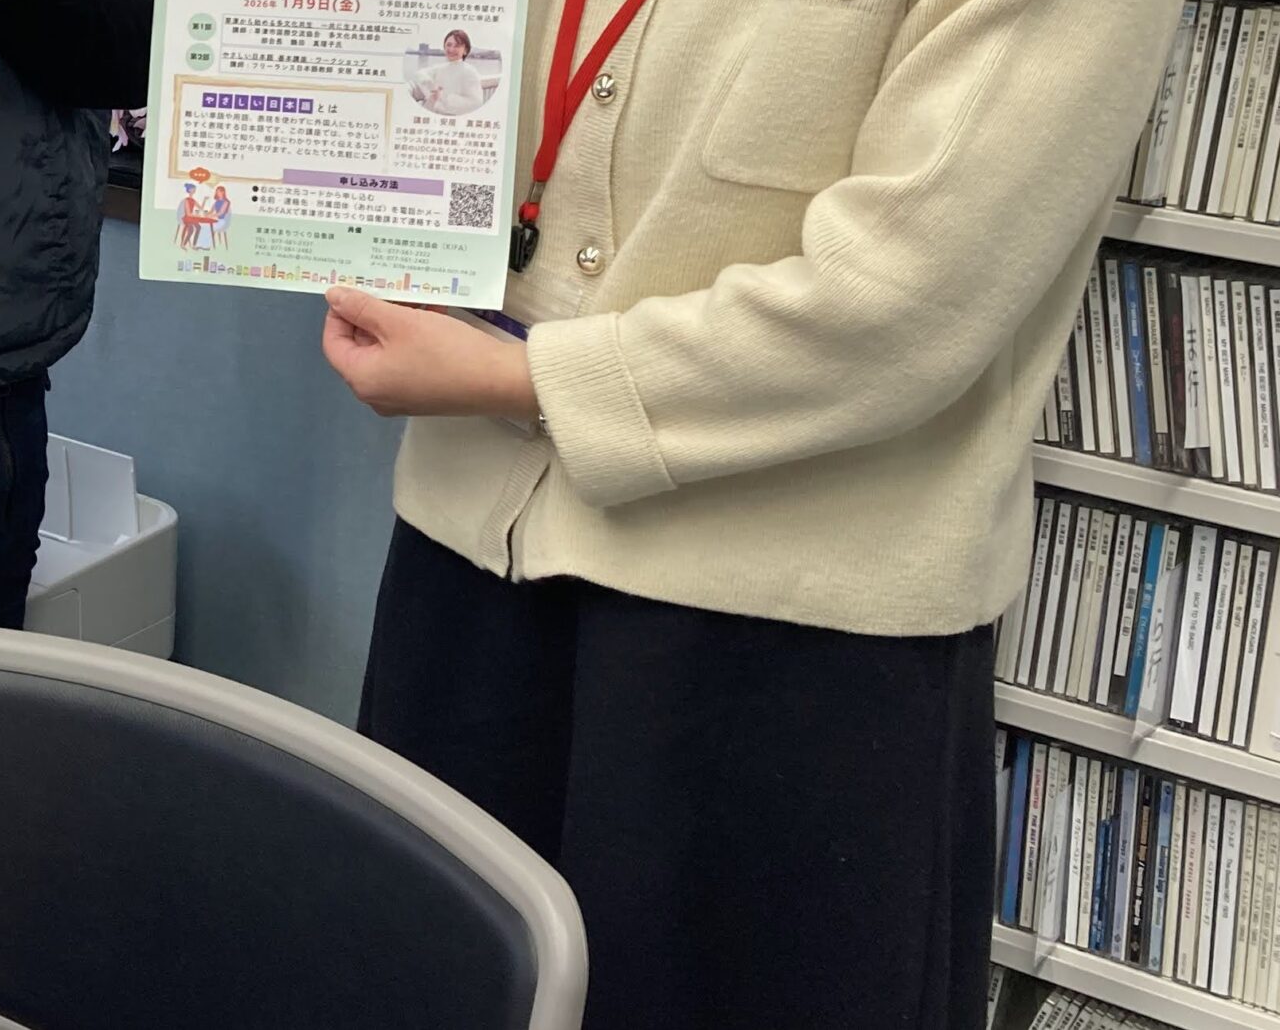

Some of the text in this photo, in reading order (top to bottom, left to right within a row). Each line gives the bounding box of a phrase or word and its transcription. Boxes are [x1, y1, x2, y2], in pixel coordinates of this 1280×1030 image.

[204, 94, 338, 113] やさしい日本語 とは
[339, 176, 398, 189] 申し込み方法
